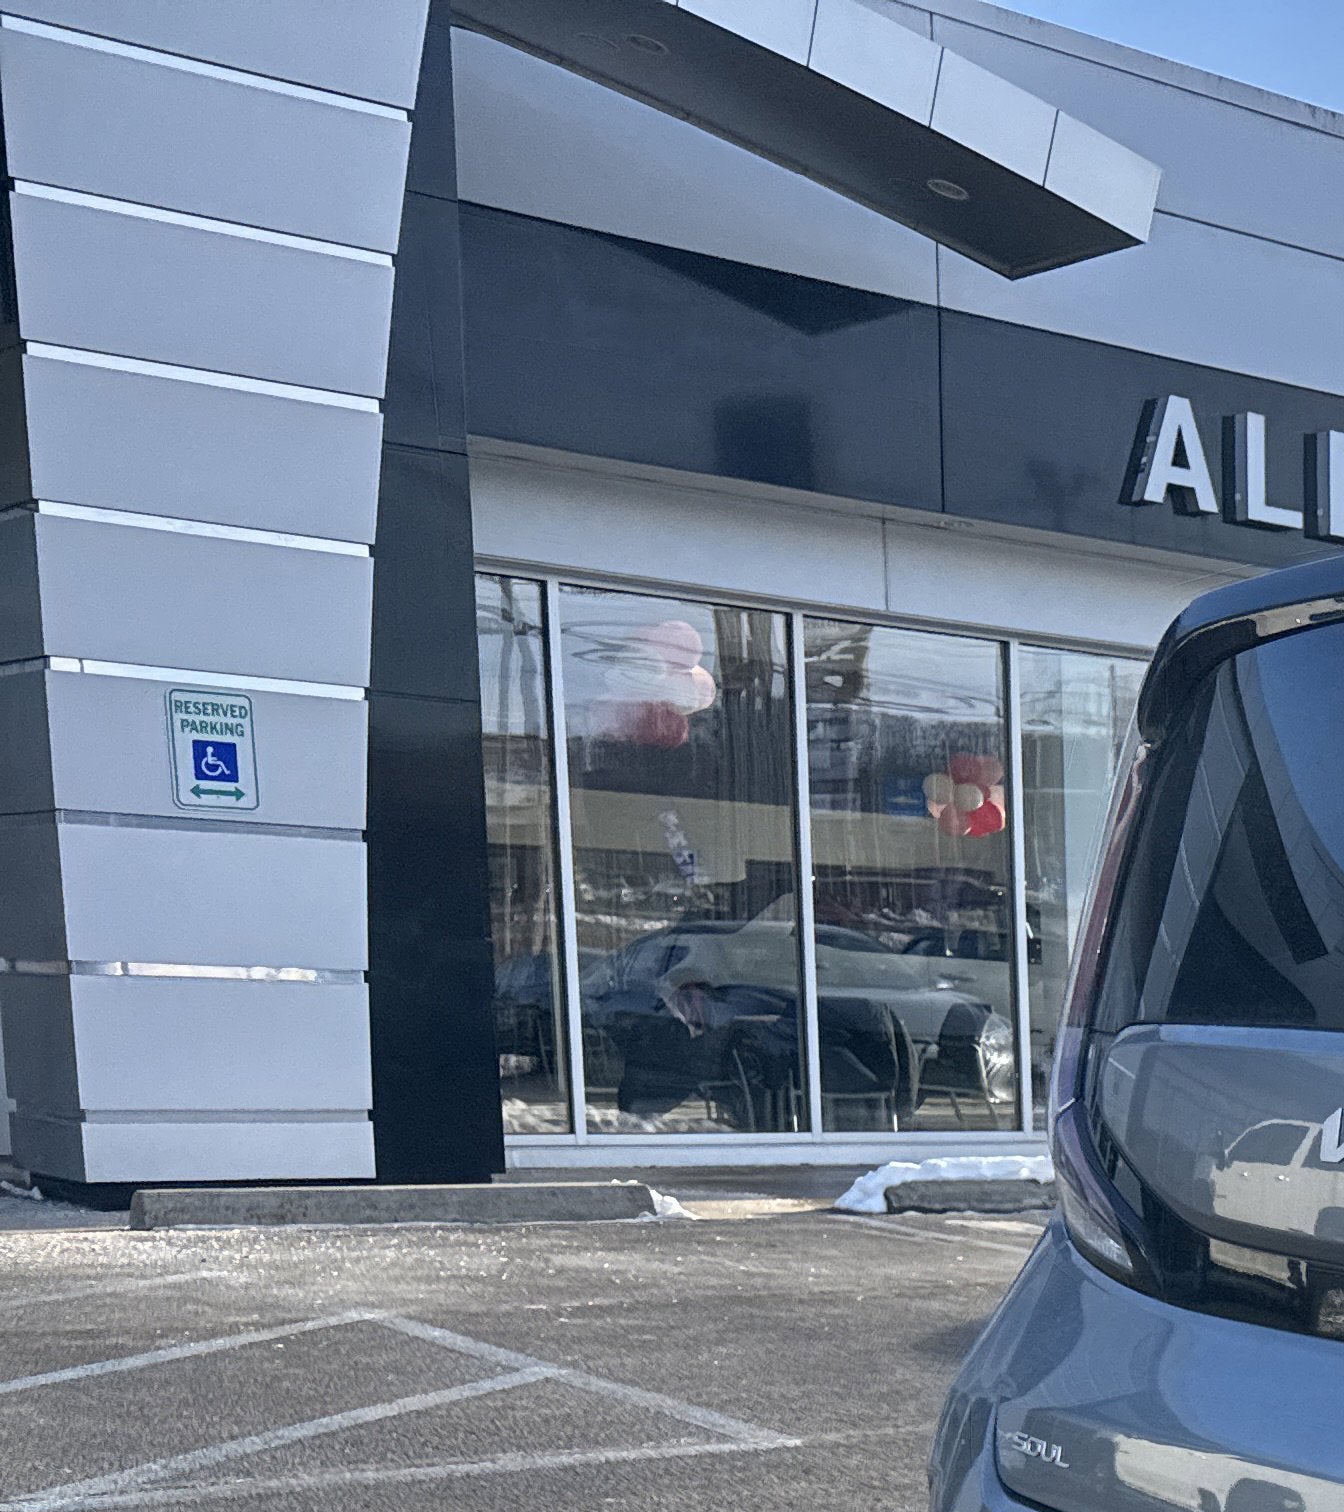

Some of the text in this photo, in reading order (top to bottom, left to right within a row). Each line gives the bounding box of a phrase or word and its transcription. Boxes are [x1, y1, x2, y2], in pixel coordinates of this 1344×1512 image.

[174, 699, 248, 719] RESERVED
[180, 718, 245, 738] PARKING
[1012, 1431, 1070, 1469] SOUL
